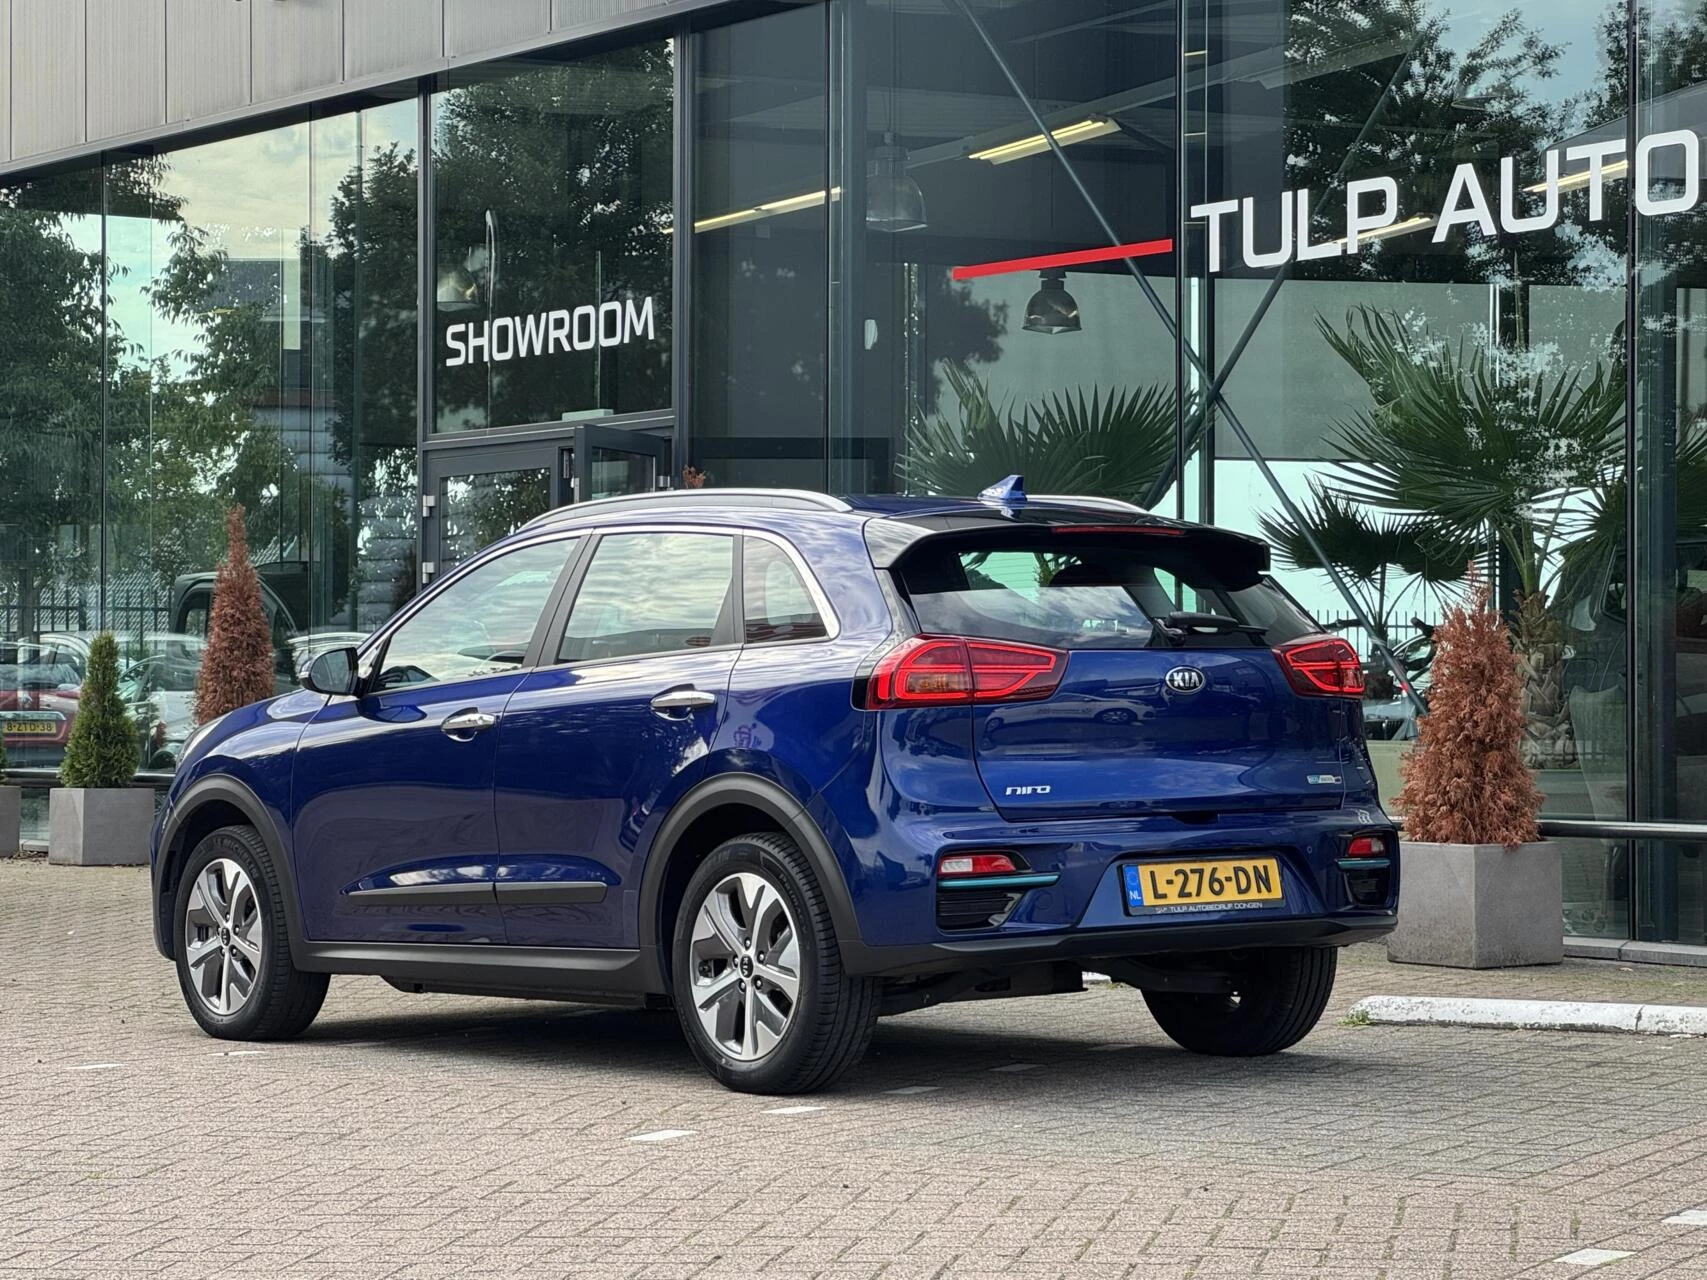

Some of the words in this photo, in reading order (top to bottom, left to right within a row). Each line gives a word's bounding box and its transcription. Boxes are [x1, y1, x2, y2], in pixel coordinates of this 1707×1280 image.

[1191, 175, 1398, 273] TULP
[1431, 128, 1699, 243] AUTO
[445, 296, 655, 367] SHOWROOM
[1173, 671, 1200, 687] KIA
[1149, 864, 1272, 900] L-276-DN
[1129, 890, 1142, 901] NL
[1169, 905, 1188, 913] TULP
[1188, 903, 1233, 912] AUTOBEDRIJF
[1234, 901, 1263, 910] DONGEN
